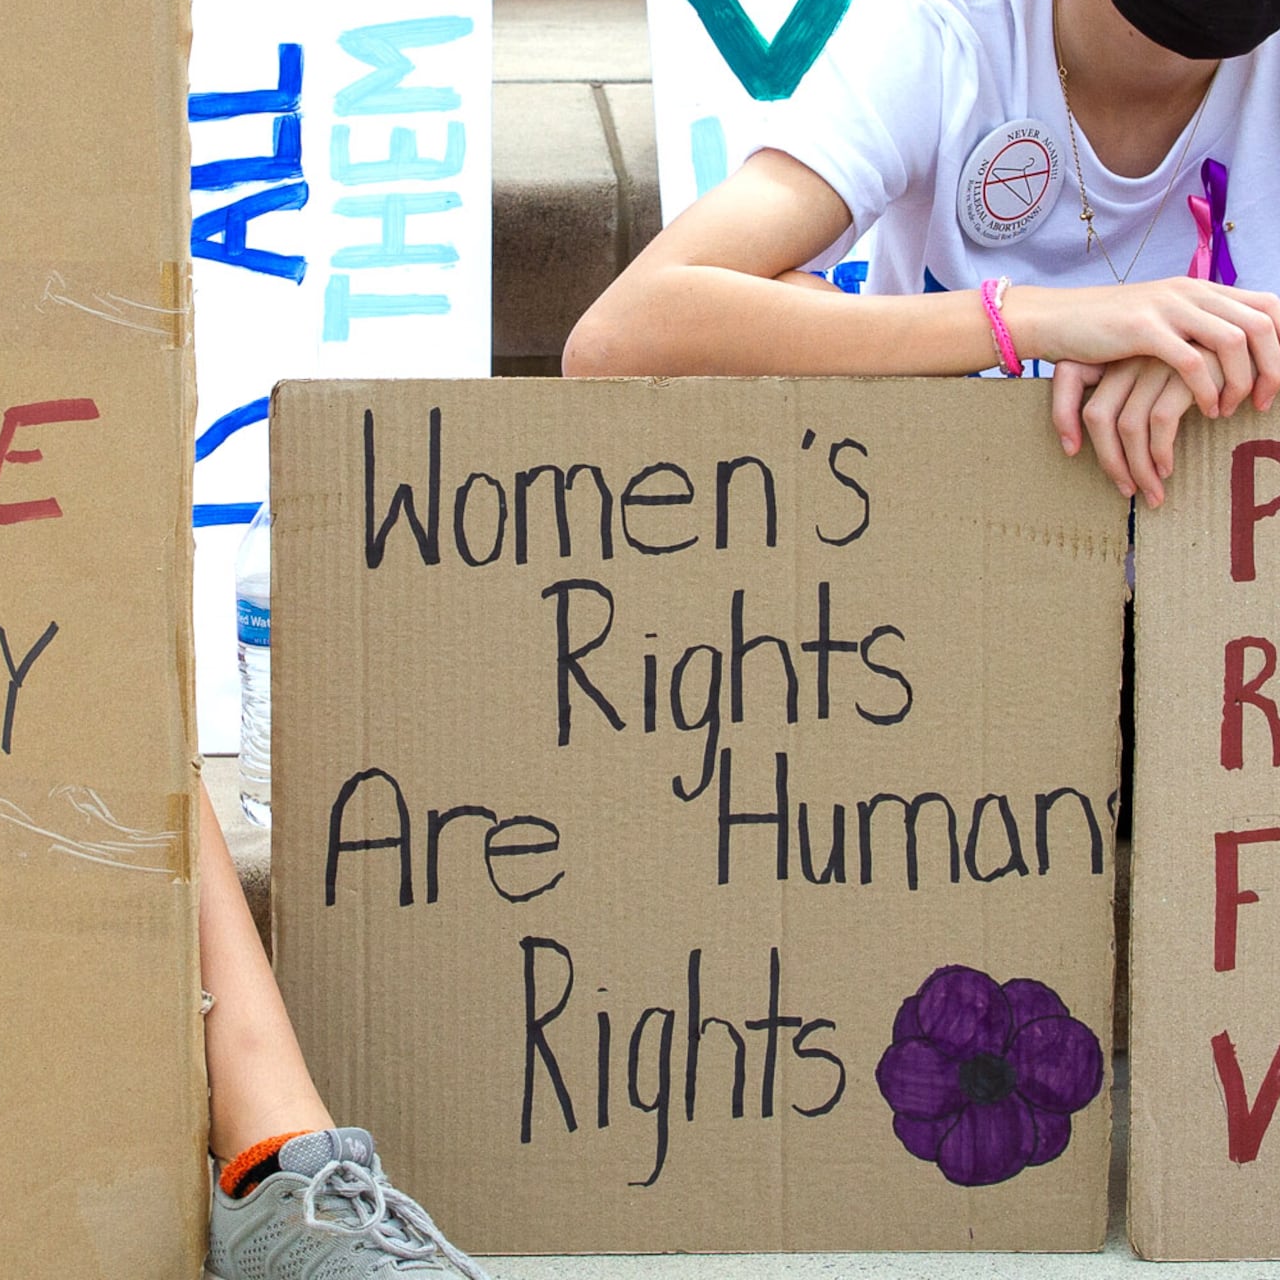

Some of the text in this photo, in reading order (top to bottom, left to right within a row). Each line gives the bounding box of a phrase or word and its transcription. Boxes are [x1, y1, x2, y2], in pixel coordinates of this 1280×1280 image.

[187, 43, 309, 286] ALL
[323, 15, 474, 342] THEM
[973, 158, 1043, 233] NO ILLEGAL ABORTIONS!
[1007, 128, 1041, 142] NEVER
[363, 406, 870, 570] Women's
[541, 578, 914, 802] Rights
[325, 767, 566, 908] Are
[519, 936, 846, 1188] Rights
